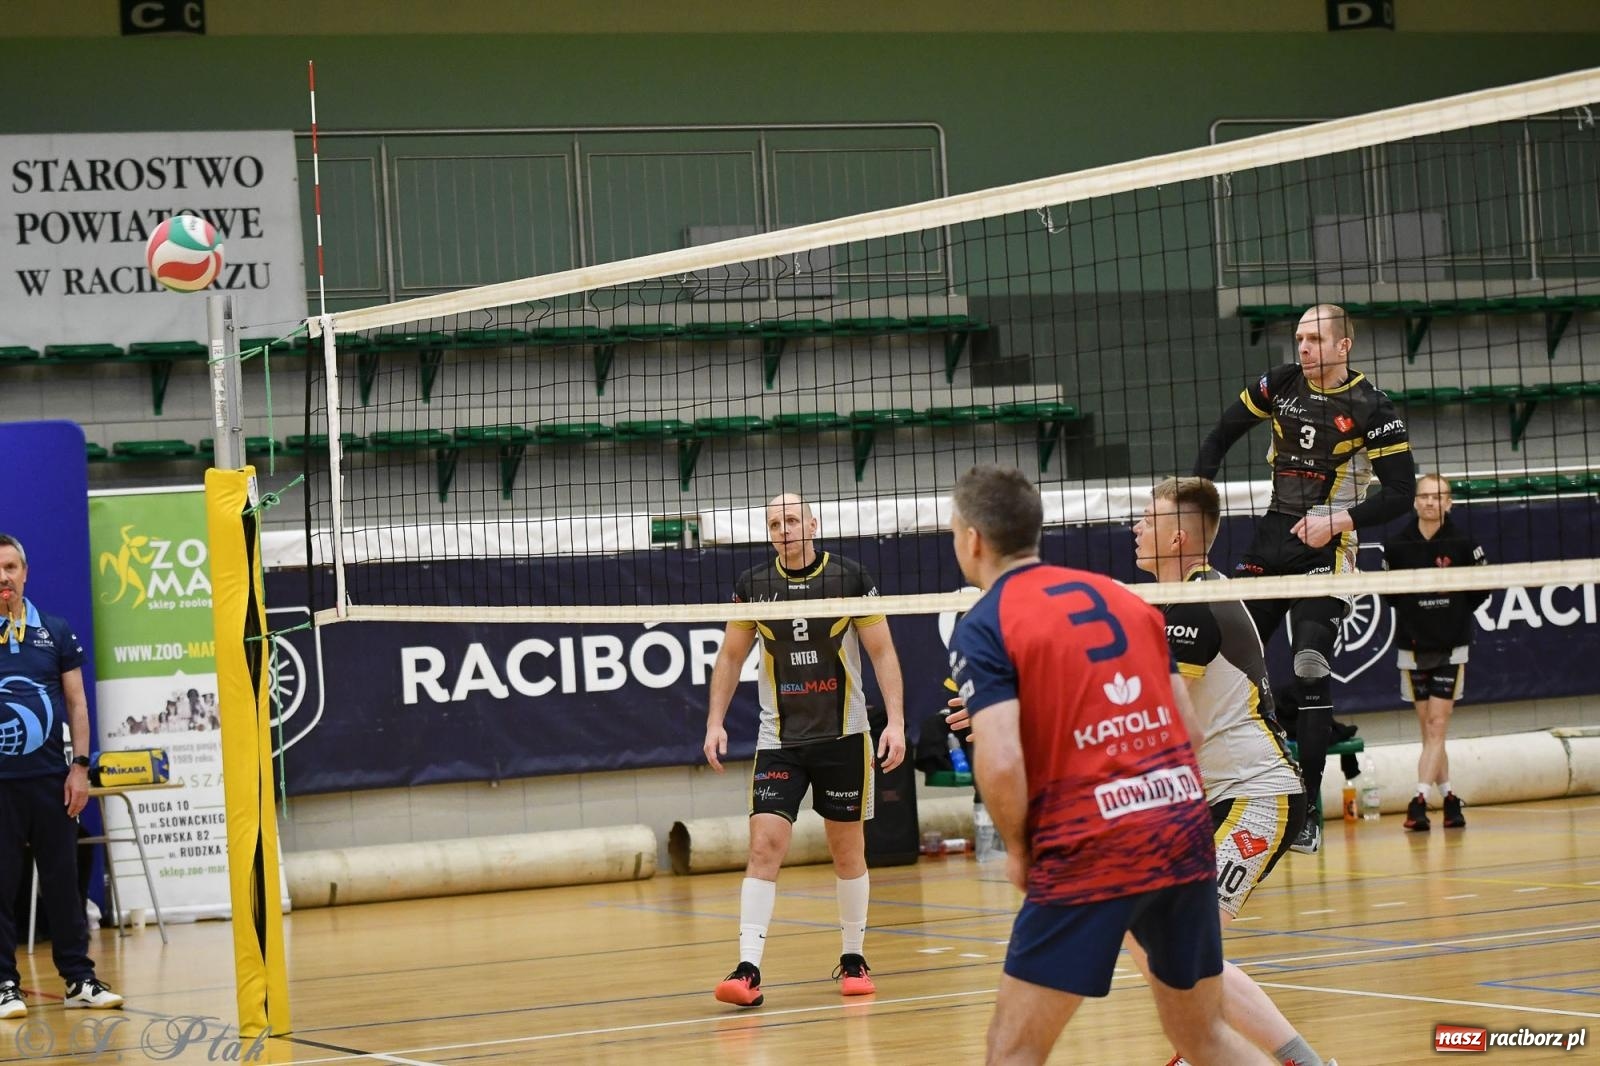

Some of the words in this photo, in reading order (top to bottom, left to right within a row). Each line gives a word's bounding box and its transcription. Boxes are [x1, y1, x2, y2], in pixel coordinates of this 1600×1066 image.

[131, 3, 165, 28] C
[183, 2, 201, 28] C
[1338, 3, 1373, 26] D
[12, 155, 264, 193] STAROSTWO
[15, 207, 264, 245] POWIATWE
[16, 269, 50, 297] W
[63, 262, 271, 296] RACIZU
[1299, 424, 1317, 450] 3
[148, 600, 176, 611] sklep
[792, 618, 809, 642] 2
[1042, 581, 1128, 664] 3
[1163, 625, 1199, 639] TON
[790, 650, 818, 666] ENTER
[1106, 731, 1170, 757] GROUP
[825, 790, 859, 798] GRAVTON
[1099, 772, 1198, 812] nowiny.pl
[138, 801, 173, 814] DŁUGA
[177, 800, 189, 811] 10
[143, 831, 192, 845] OPAWSKA
[196, 830, 210, 841] 82
[180, 845, 222, 857] RUDZKA
[1218, 860, 1247, 894] 10
